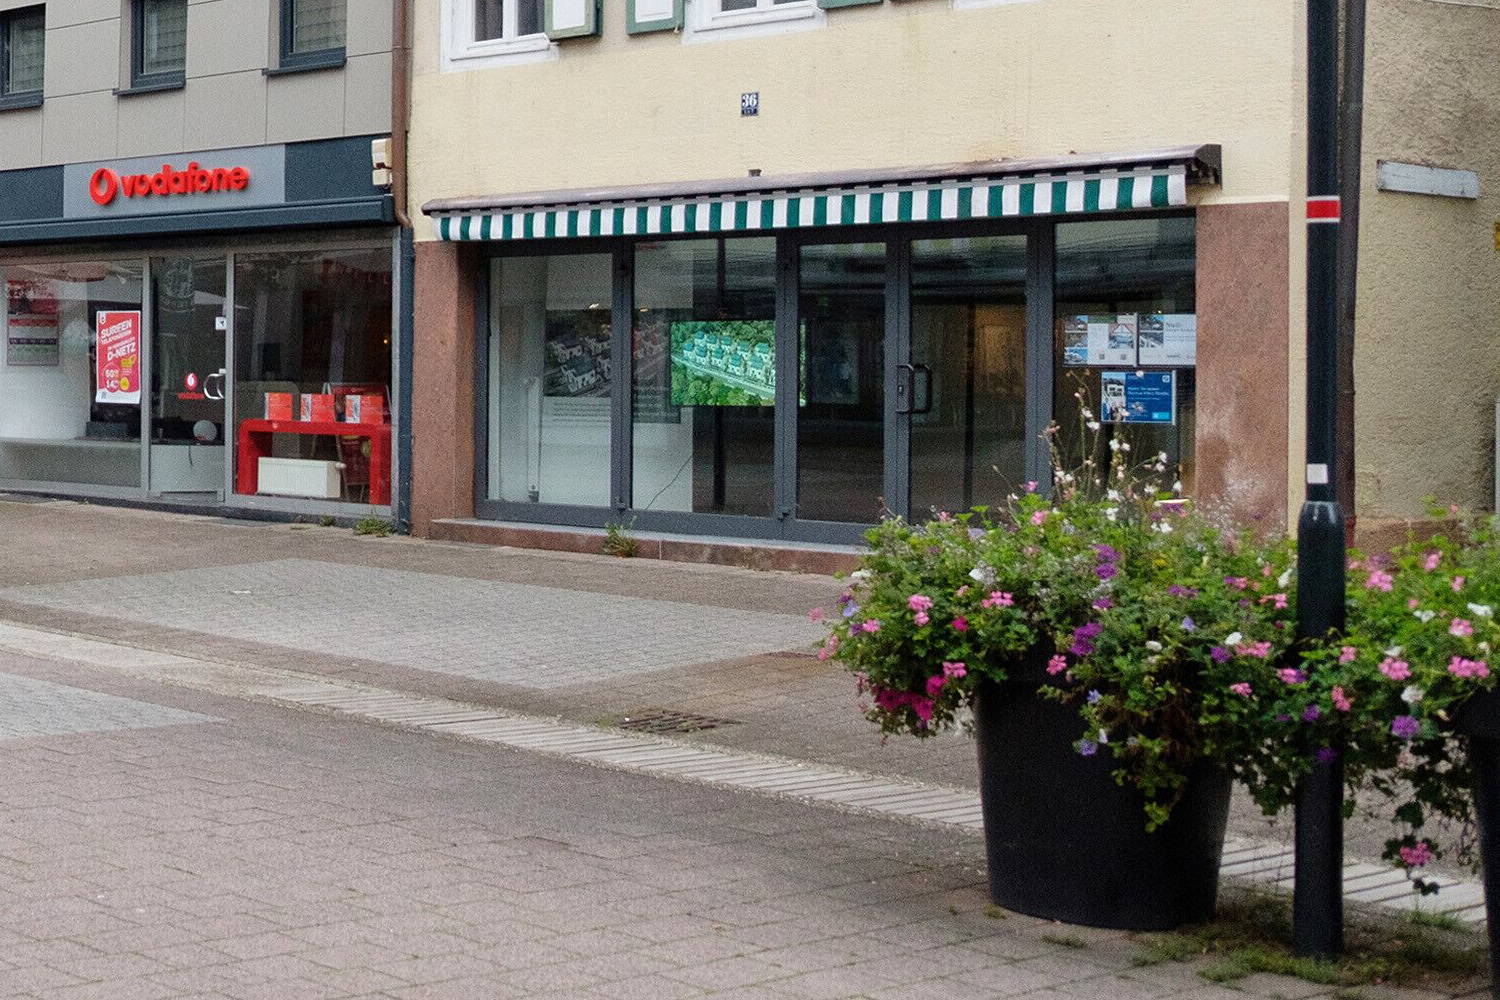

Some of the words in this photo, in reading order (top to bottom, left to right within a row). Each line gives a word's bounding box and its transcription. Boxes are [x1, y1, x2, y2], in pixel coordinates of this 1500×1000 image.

[742, 94, 757, 107] 36
[120, 161, 250, 198] vodafone
[101, 319, 133, 339] SURFEN
[107, 342, 136, 361] D-NETZ
